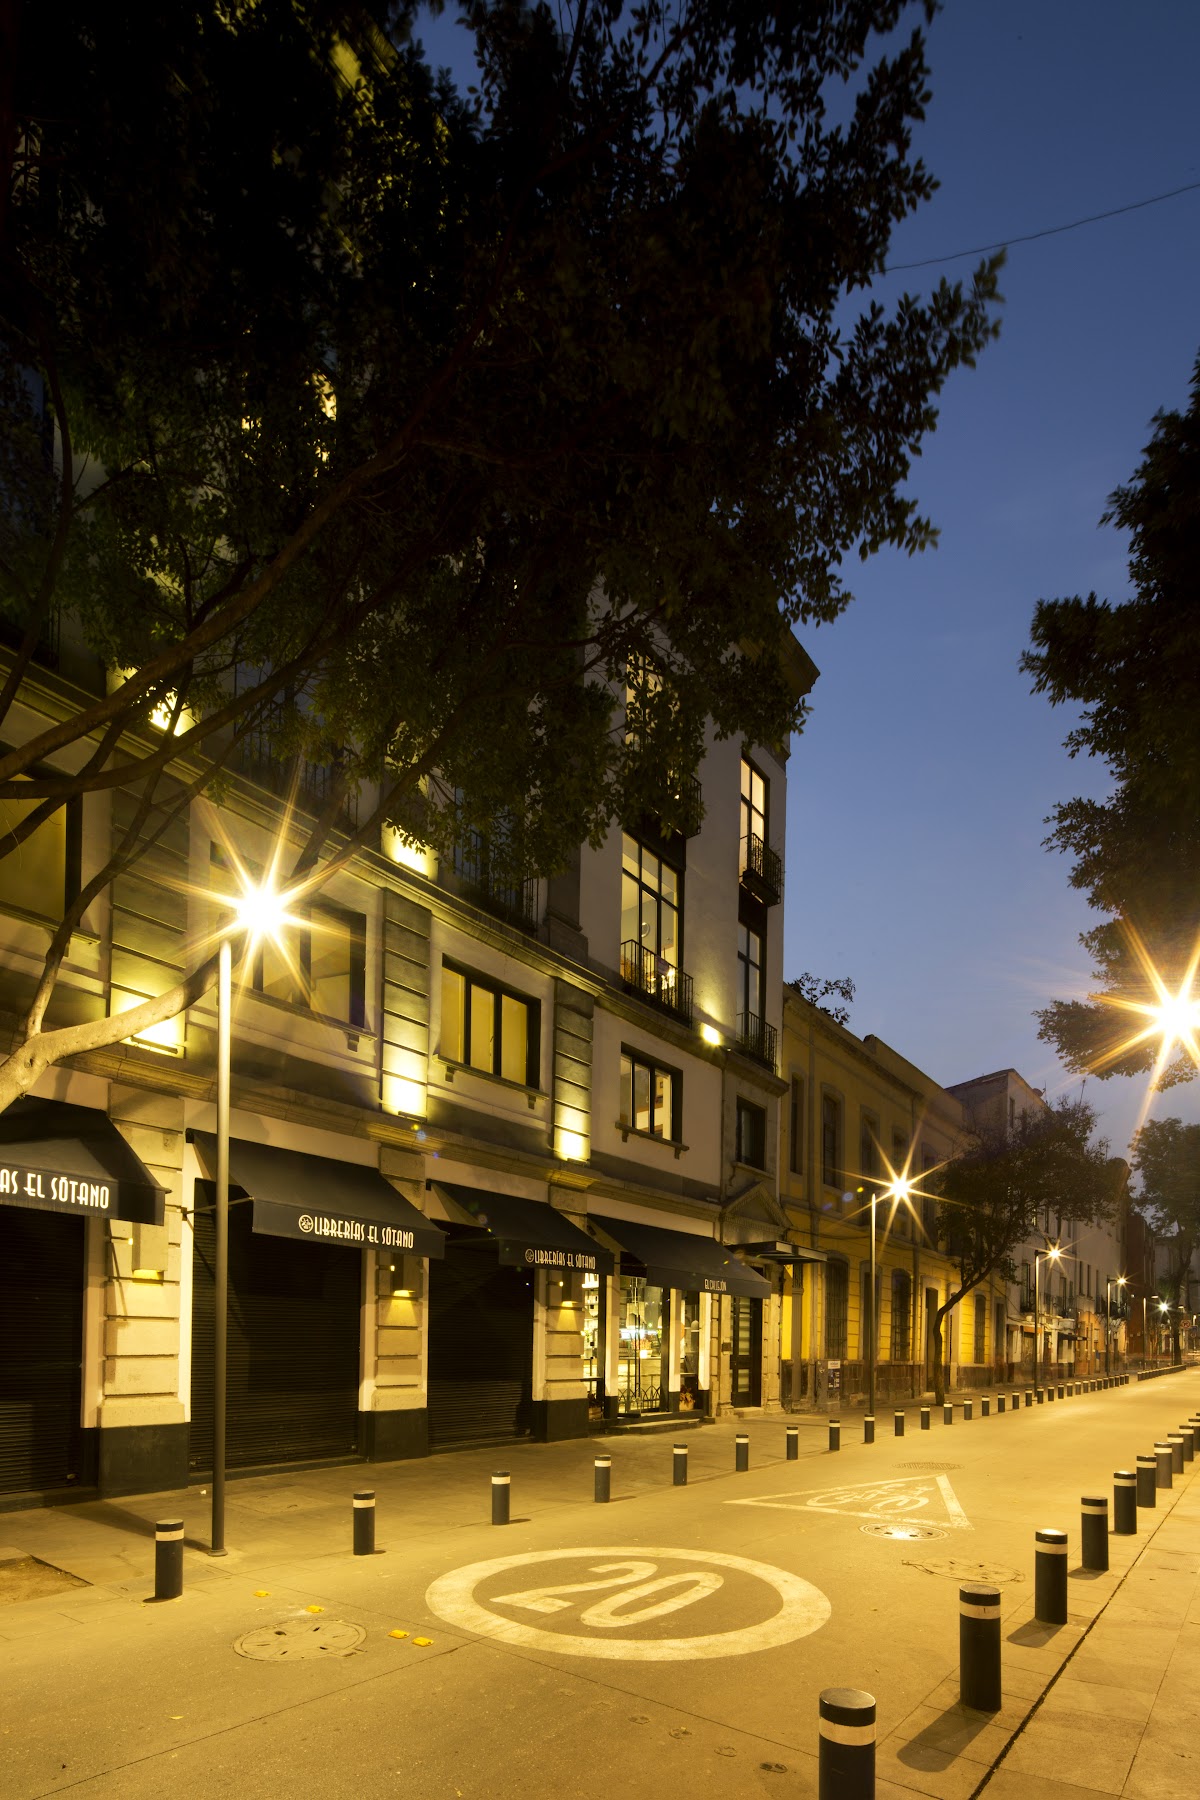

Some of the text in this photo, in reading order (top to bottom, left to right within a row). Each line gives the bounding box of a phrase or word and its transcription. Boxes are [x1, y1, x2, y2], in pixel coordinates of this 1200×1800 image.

[23, 1173, 45, 1198] EL
[51, 1177, 109, 1208] SÓTANO
[314, 1216, 414, 1248] LIBRERÍAS EL SÓTANO
[567, 1253, 574, 1267] EL
[489, 1562, 724, 1628] 20
